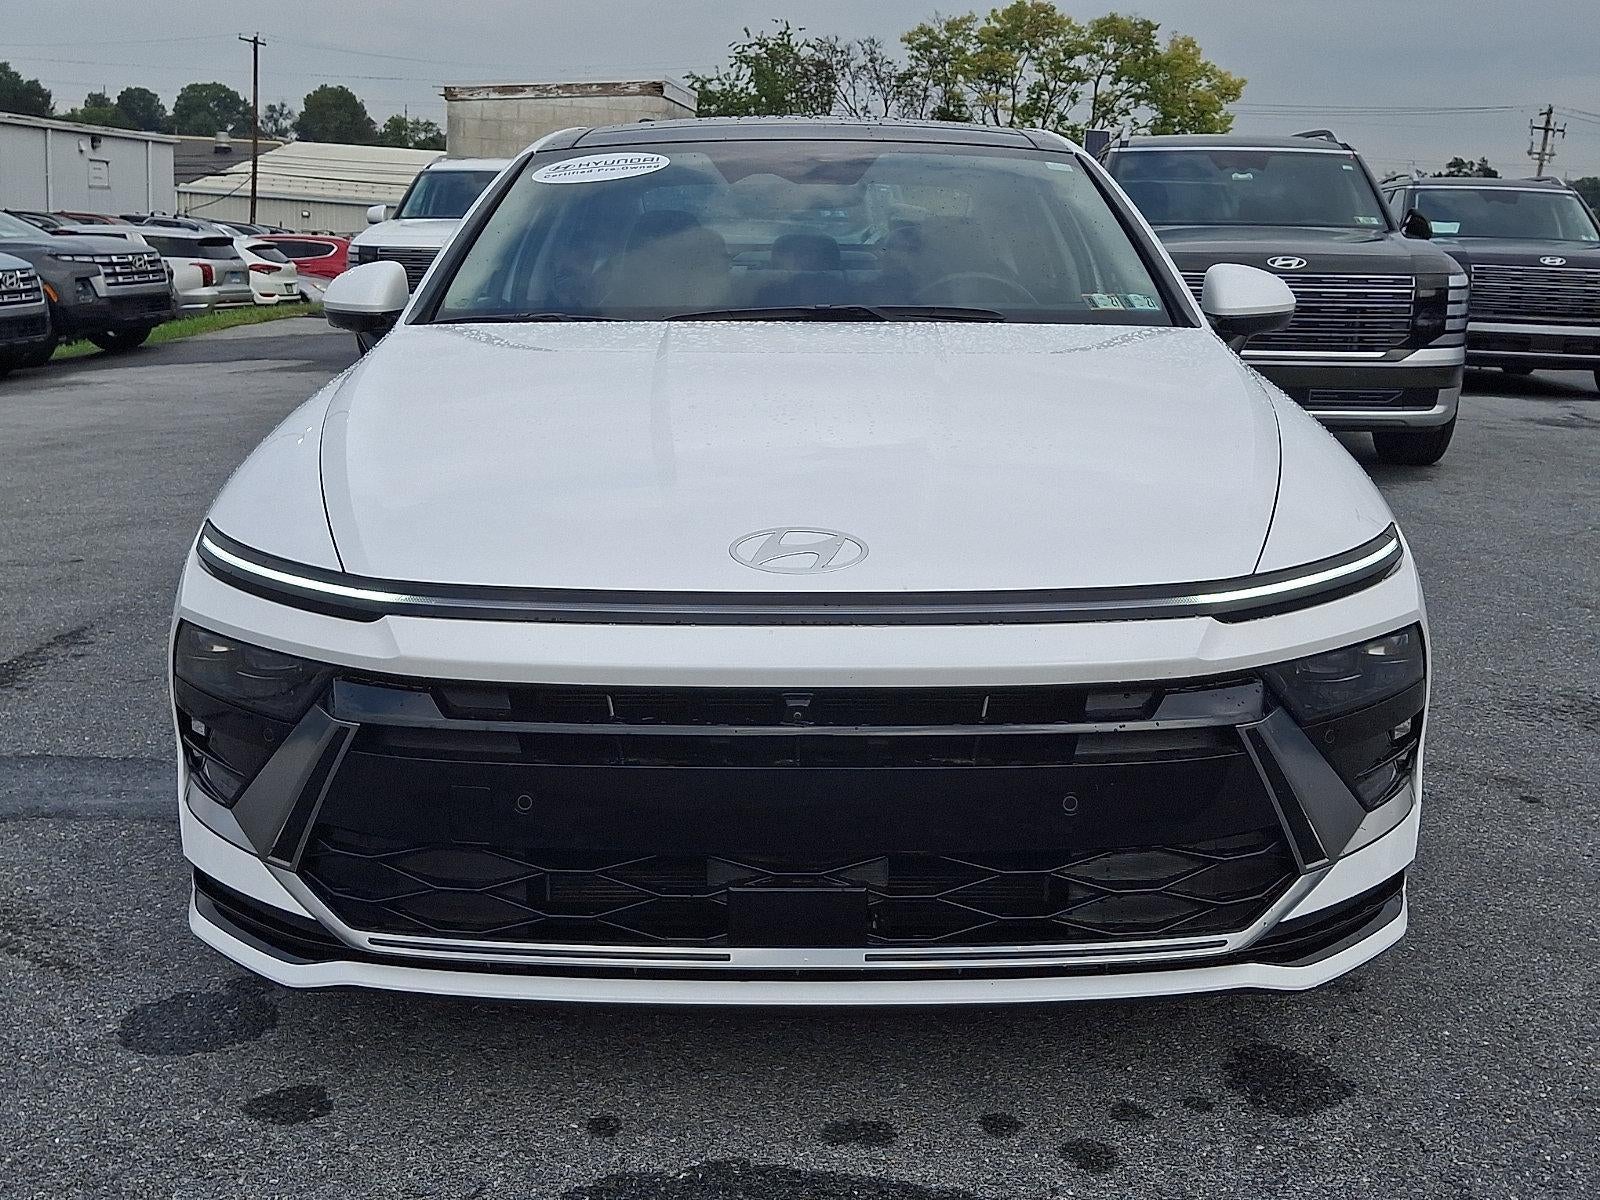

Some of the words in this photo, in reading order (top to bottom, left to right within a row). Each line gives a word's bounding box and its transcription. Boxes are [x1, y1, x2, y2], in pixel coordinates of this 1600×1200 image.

[578, 157, 660, 168] HYUNDAI
[543, 169, 593, 179] Certified
[597, 164, 660, 173] Pre-Owned
